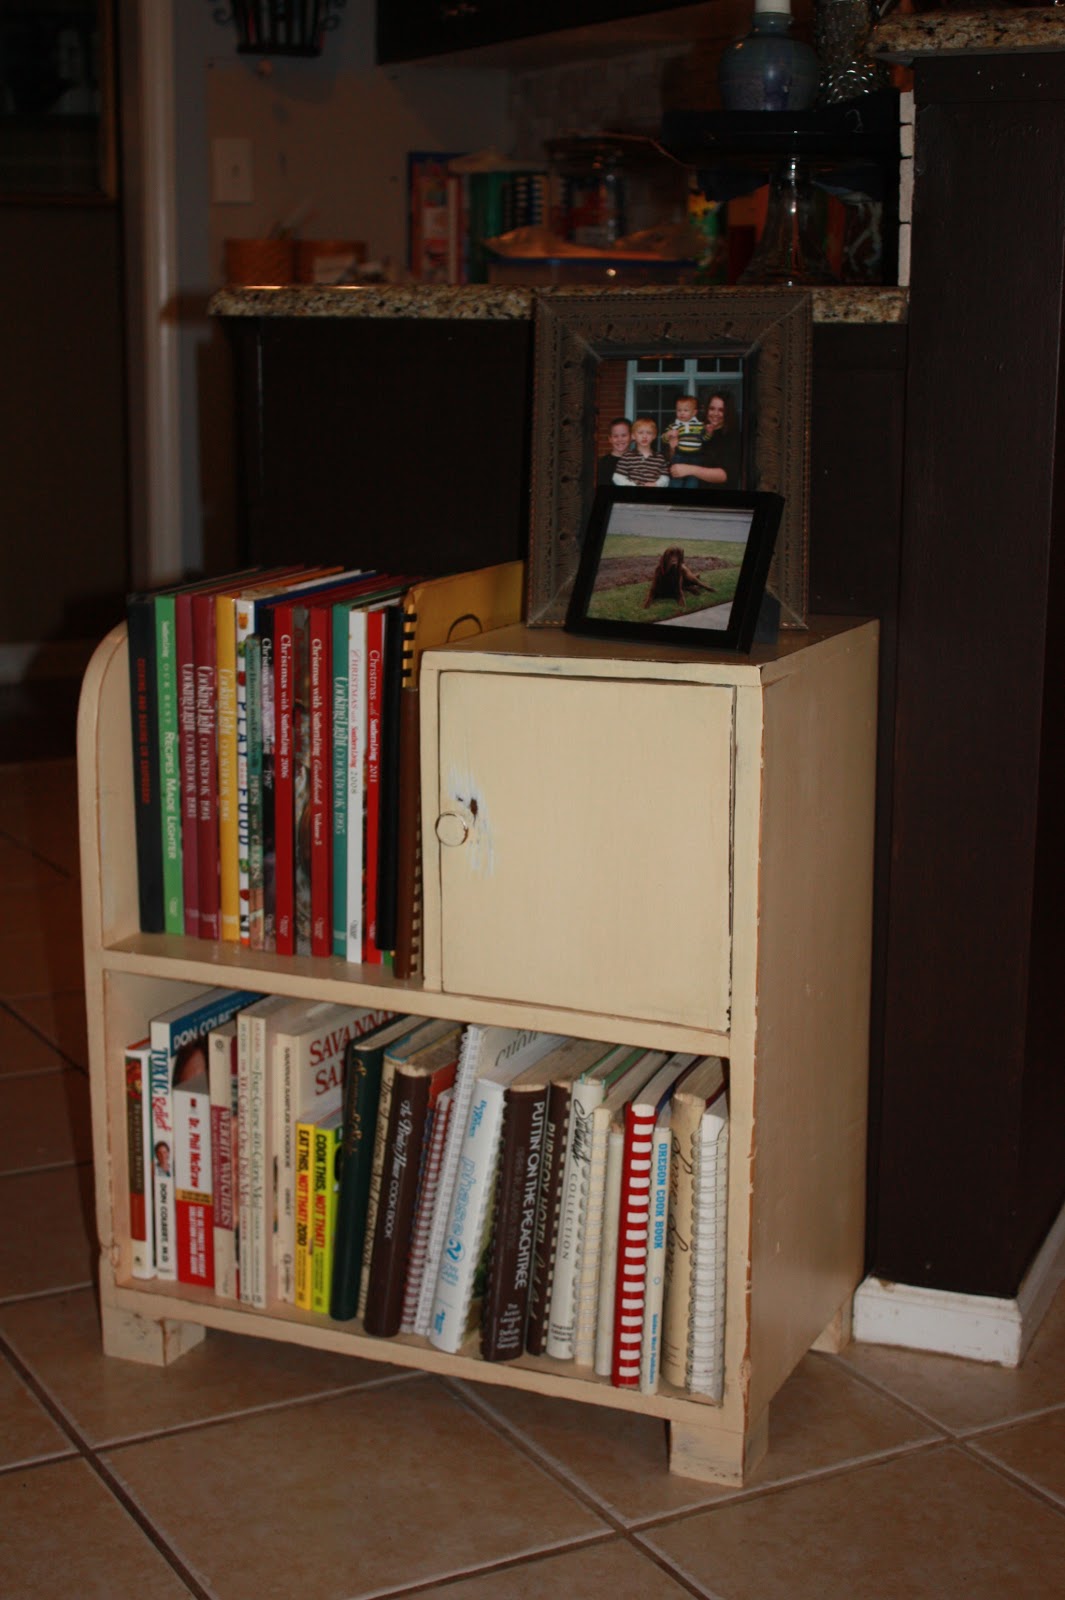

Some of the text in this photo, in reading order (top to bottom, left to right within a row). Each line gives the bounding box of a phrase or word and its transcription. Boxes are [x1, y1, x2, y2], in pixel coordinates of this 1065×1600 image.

[262, 637, 272, 685] Christmas
[280, 634, 291, 688] Christmas
[312, 638, 322, 685] Christmas
[369, 650, 381, 700] Christmas
[350, 649, 361, 709] CHRISTMAS
[281, 691, 290, 710] with
[312, 687, 322, 708] with
[238, 701, 248, 758] PLAY
[165, 731, 176, 774] RECIPES
[200, 737, 210, 796] COOKBOOK
[280, 758, 289, 778] 2006
[334, 748, 346, 809] COOKBOOK
[350, 771, 358, 794] 2008
[369, 764, 377, 783] 2011
[166, 778, 177, 811] MADE
[251, 775, 260, 805] PIES
[238, 788, 249, 845] FOOD
[314, 813, 323, 839] Volume
[168, 816, 178, 859] LIGHTER
[251, 835, 260, 880] CAKES
[173, 1025, 198, 1049] DON
[151, 1048, 169, 1095] TOXIC
[152, 1096, 172, 1132] Relief
[399, 1099, 412, 1117] The
[189, 1117, 200, 1130] Dr.
[299, 1129, 310, 1146] EAT
[189, 1132, 201, 1150] Phil
[316, 1134, 327, 1162] COOK
[190, 1151, 202, 1188] McGraw
[219, 1110, 232, 1226] WEIGHT WATCHERS
[298, 1148, 309, 1173] THIS,
[527, 1152, 540, 1178] ON
[657, 1143, 668, 1186] OREGON
[160, 1183, 168, 1204] DON
[298, 1174, 309, 1194] NOT
[315, 1166, 327, 1192] THIS,
[523, 1178, 536, 1207] THE
[315, 1193, 326, 1216] NOT
[387, 1179, 399, 1209] COOK
[453, 1157, 476, 1236] phase
[655, 1189, 666, 1217] COOK
[298, 1196, 309, 1223] THAT!
[562, 1173, 578, 1260] COLLECTION
[297, 1223, 308, 1247] 2010
[315, 1217, 326, 1248] THAT!
[383, 1210, 395, 1239] BOOK
[654, 1221, 664, 1249] BOOK
[514, 1210, 532, 1290] PEACHTREE
